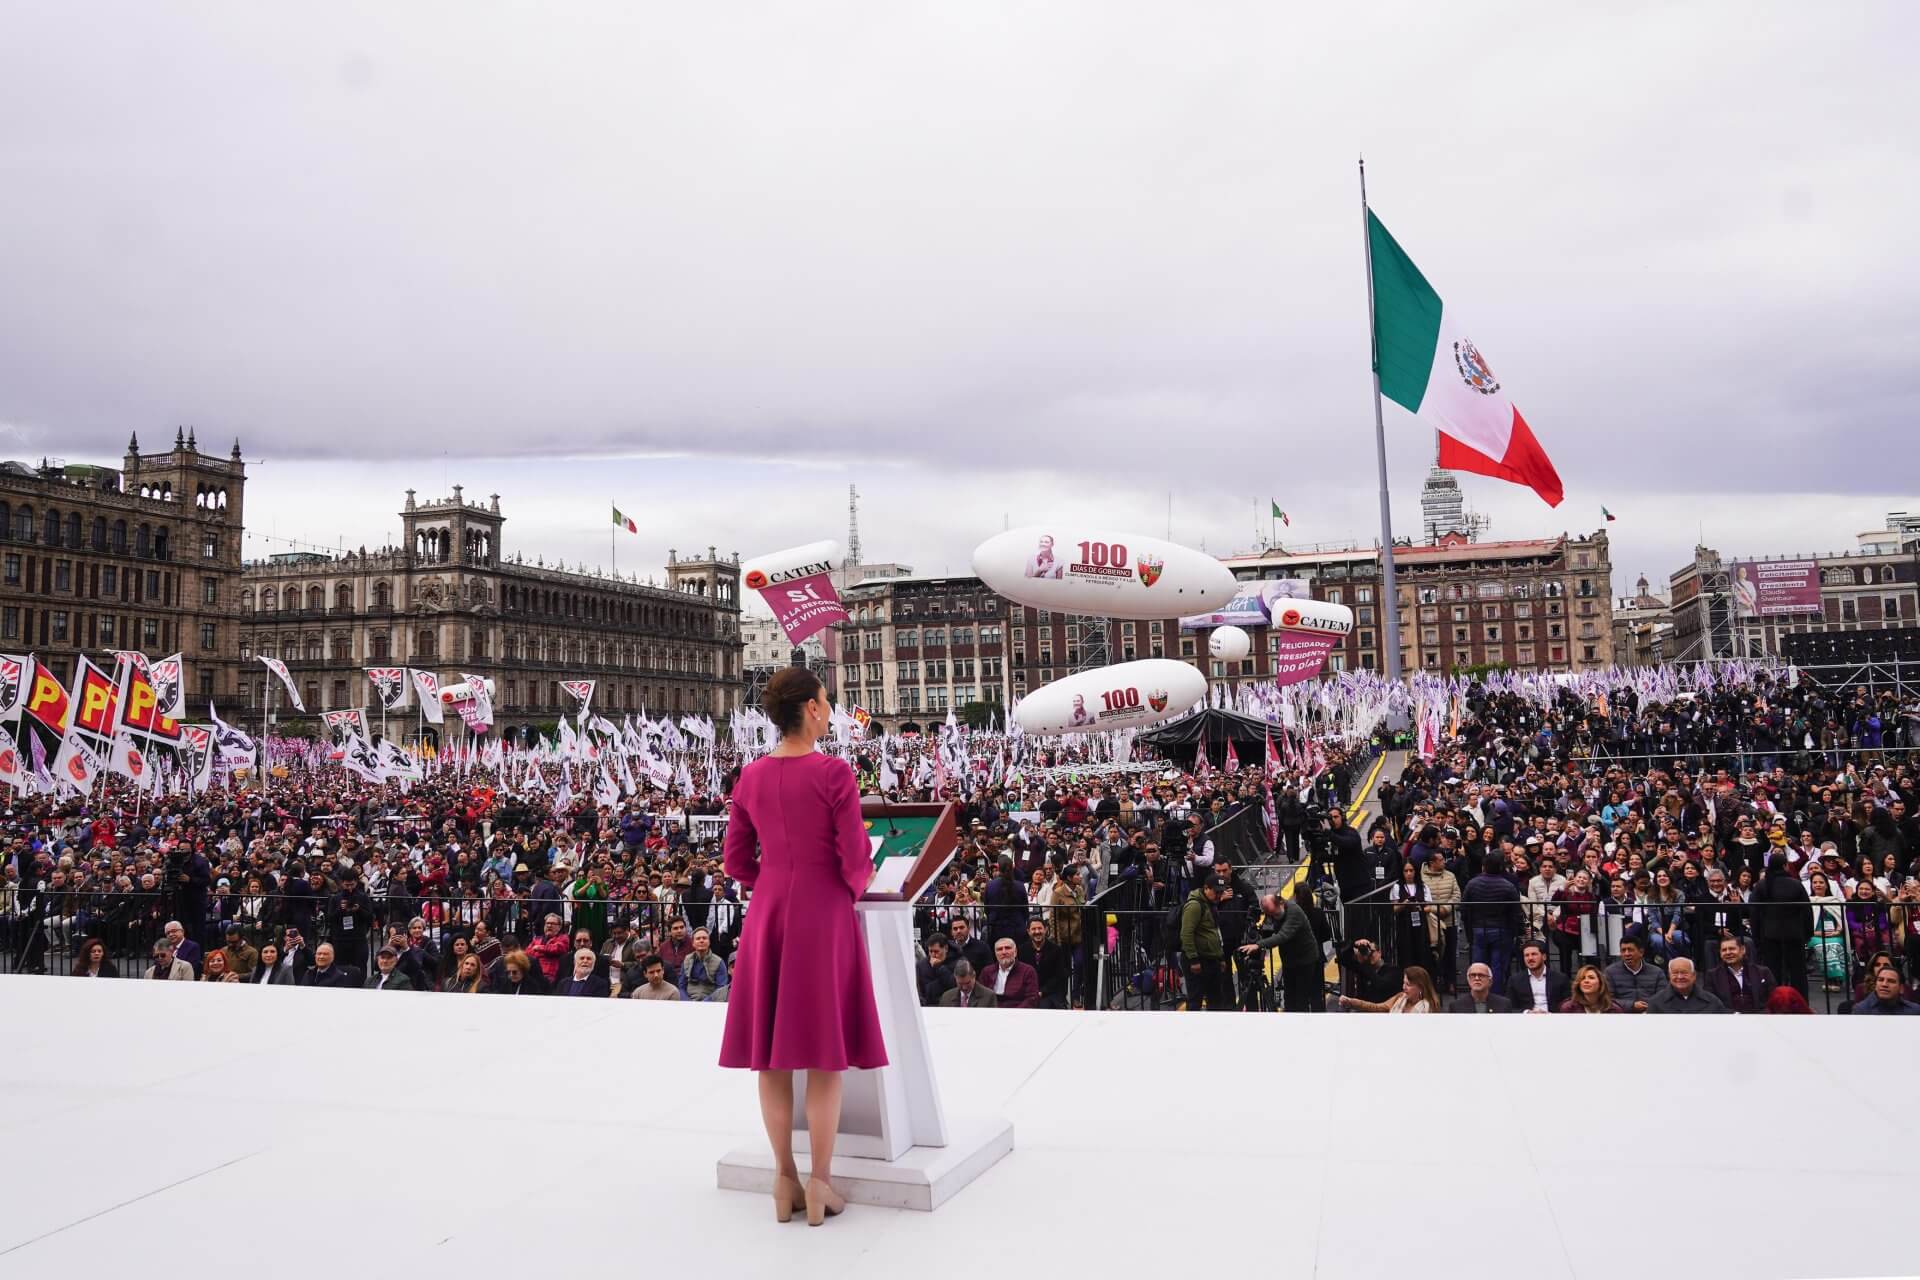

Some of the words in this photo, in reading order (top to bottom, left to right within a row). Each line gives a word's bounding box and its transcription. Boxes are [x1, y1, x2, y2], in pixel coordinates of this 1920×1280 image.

[1077, 541, 1127, 568] 100
[770, 560, 833, 584] CATEM
[1072, 564, 1088, 573] DÍAS
[1098, 568, 1131, 577] GOBIERNO
[786, 583, 822, 603] SÍ
[782, 614, 790, 622] A
[789, 607, 801, 618] LA
[785, 618, 801, 632] DE
[1300, 616, 1351, 632] CATEM
[1279, 650, 1327, 661] PRESIDENTA
[1278, 664, 1296, 673] 100
[1297, 658, 1322, 671] DÍAS
[1100, 687, 1140, 710] 100
